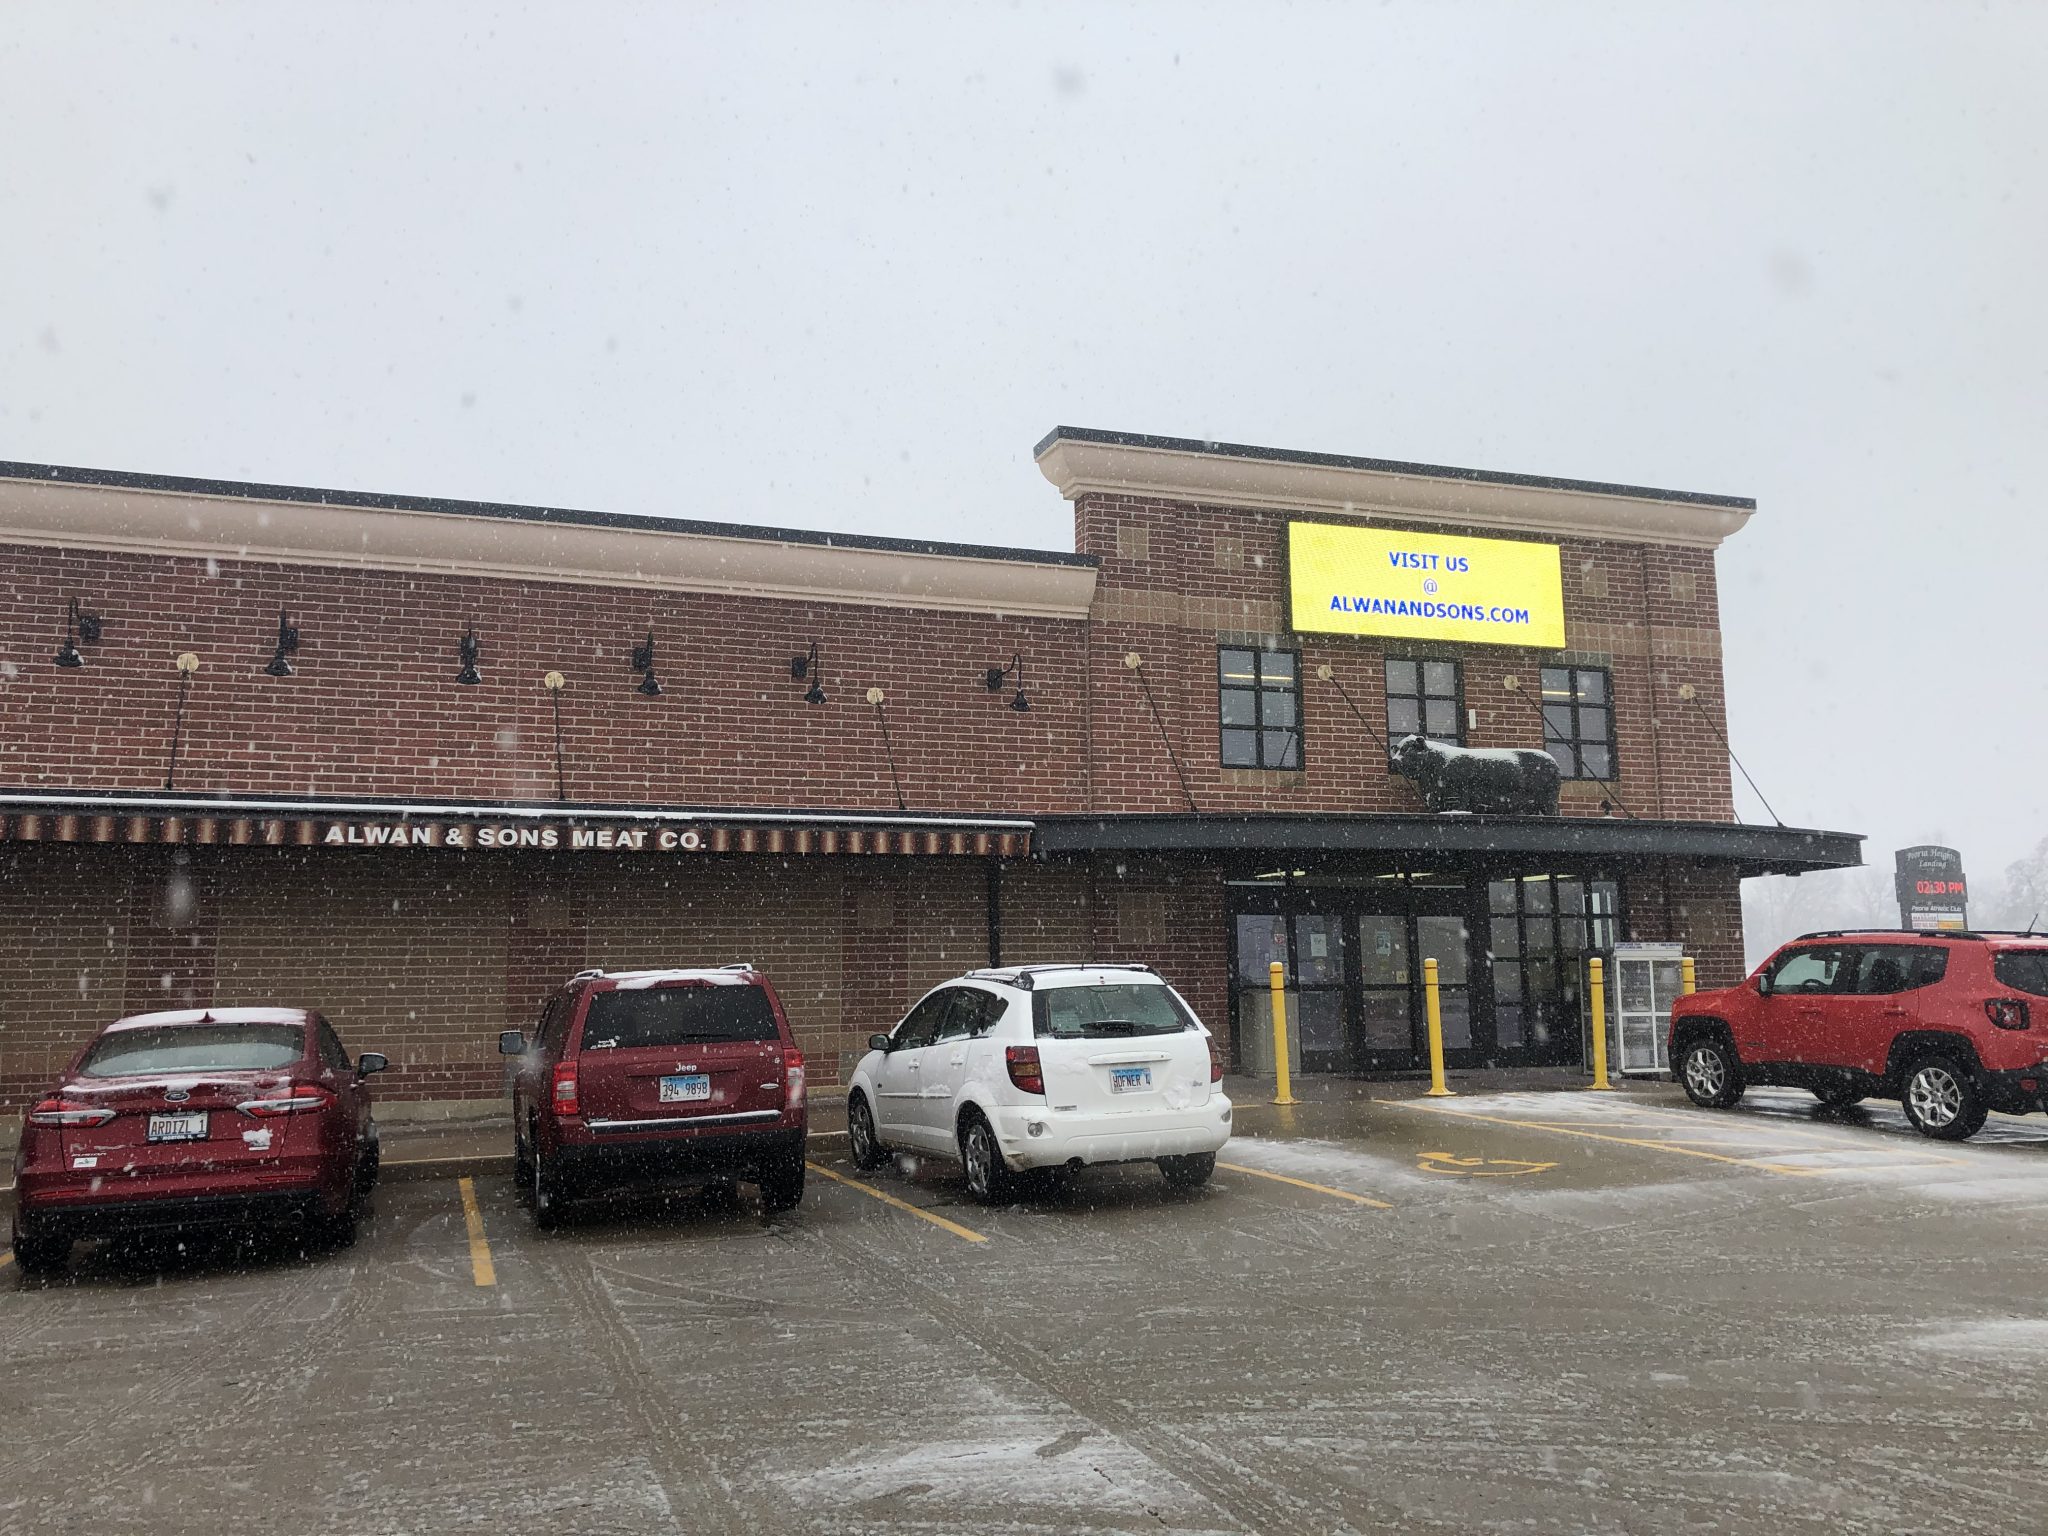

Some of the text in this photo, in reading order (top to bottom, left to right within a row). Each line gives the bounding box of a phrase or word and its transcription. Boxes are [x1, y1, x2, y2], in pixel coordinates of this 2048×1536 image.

[1389, 551, 1469, 573] VISIT US
[1423, 578, 1438, 595] @
[1330, 595, 1529, 624] ALWANANDSONS.COM
[324, 825, 707, 849] ALWAN & SONS MEAT CO.
[1916, 880, 1964, 894] 02:30 PM
[675, 1062, 697, 1072] Jeep
[662, 1082, 708, 1097] 394 9898
[150, 1119, 206, 1136] ARDIZL 1
